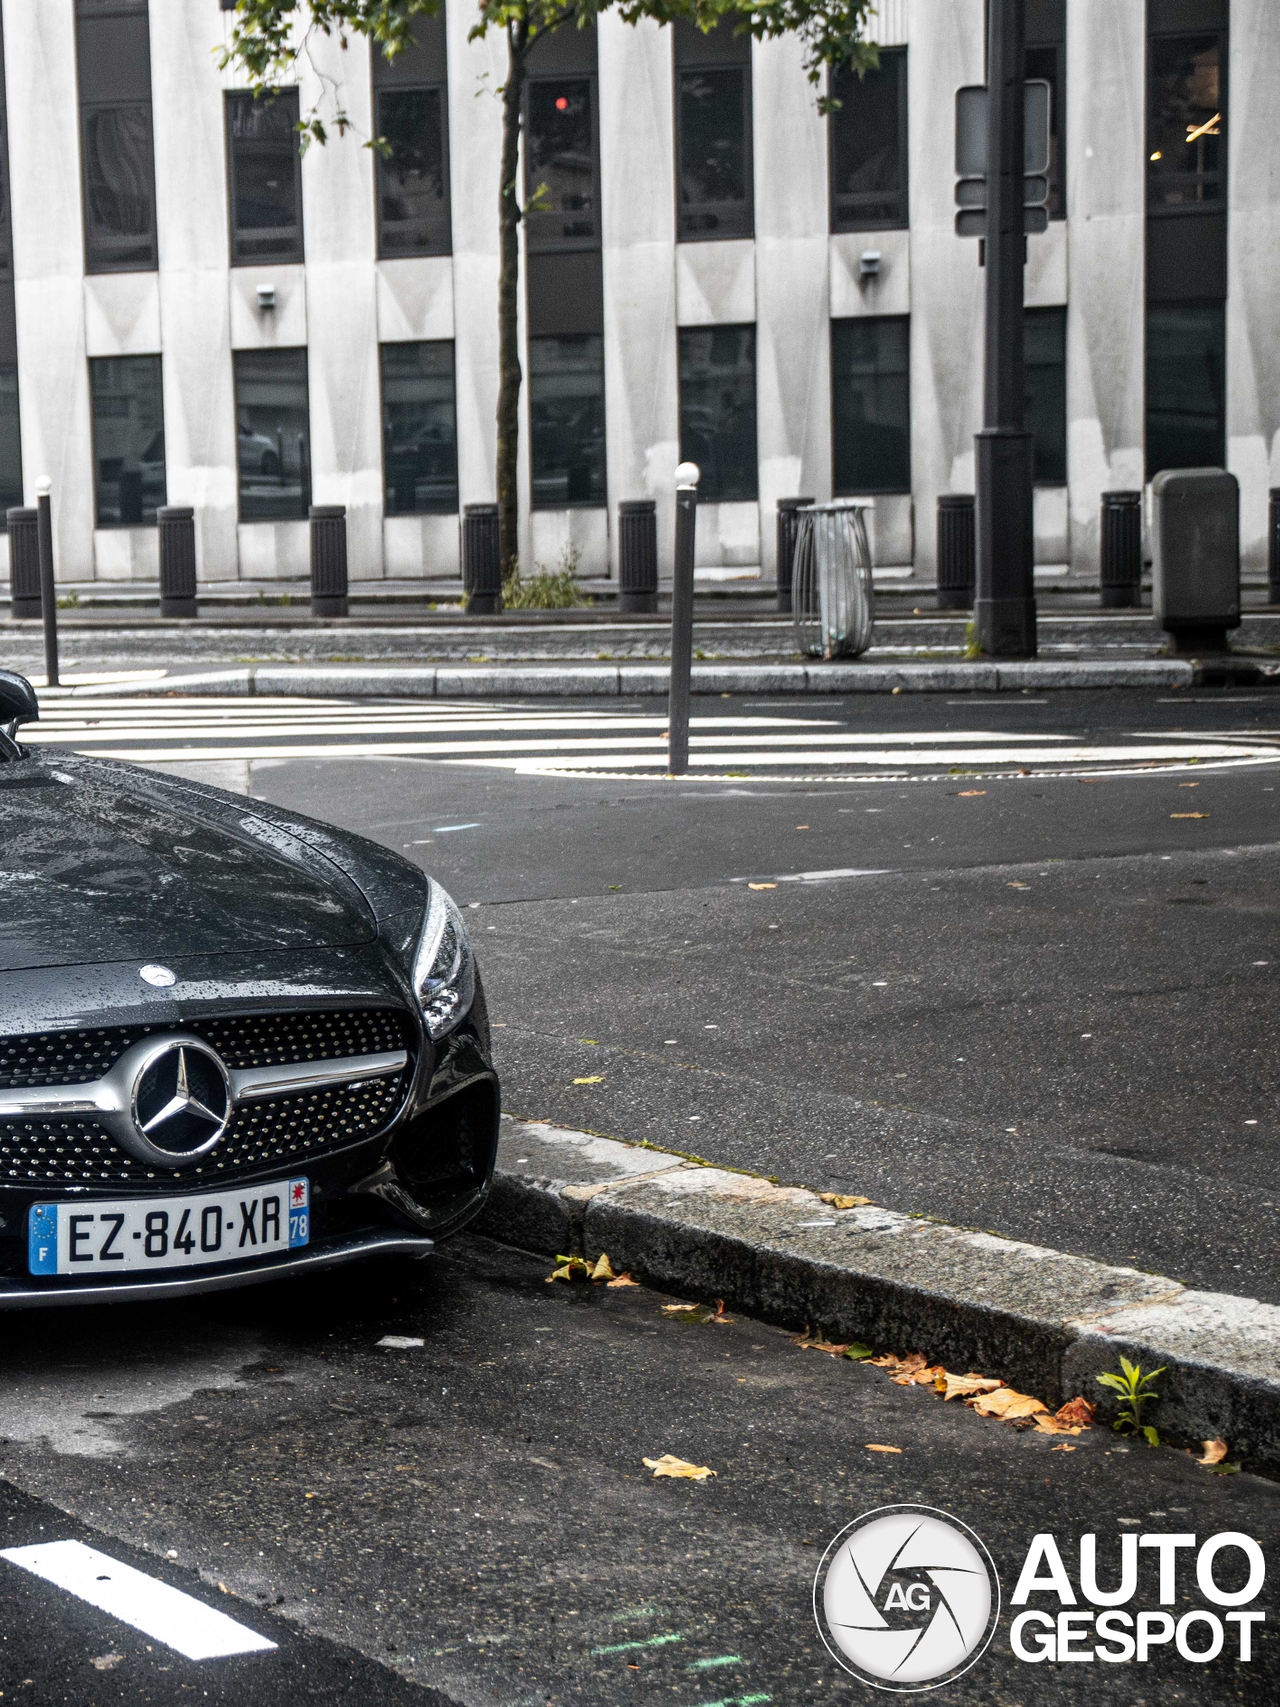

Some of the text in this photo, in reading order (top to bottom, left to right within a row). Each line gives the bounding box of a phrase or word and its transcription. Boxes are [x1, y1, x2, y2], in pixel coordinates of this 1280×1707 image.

[69, 1195, 280, 1262] EZ-840-XR
[290, 1214, 307, 1239] 78
[39, 1247, 49, 1262] F
